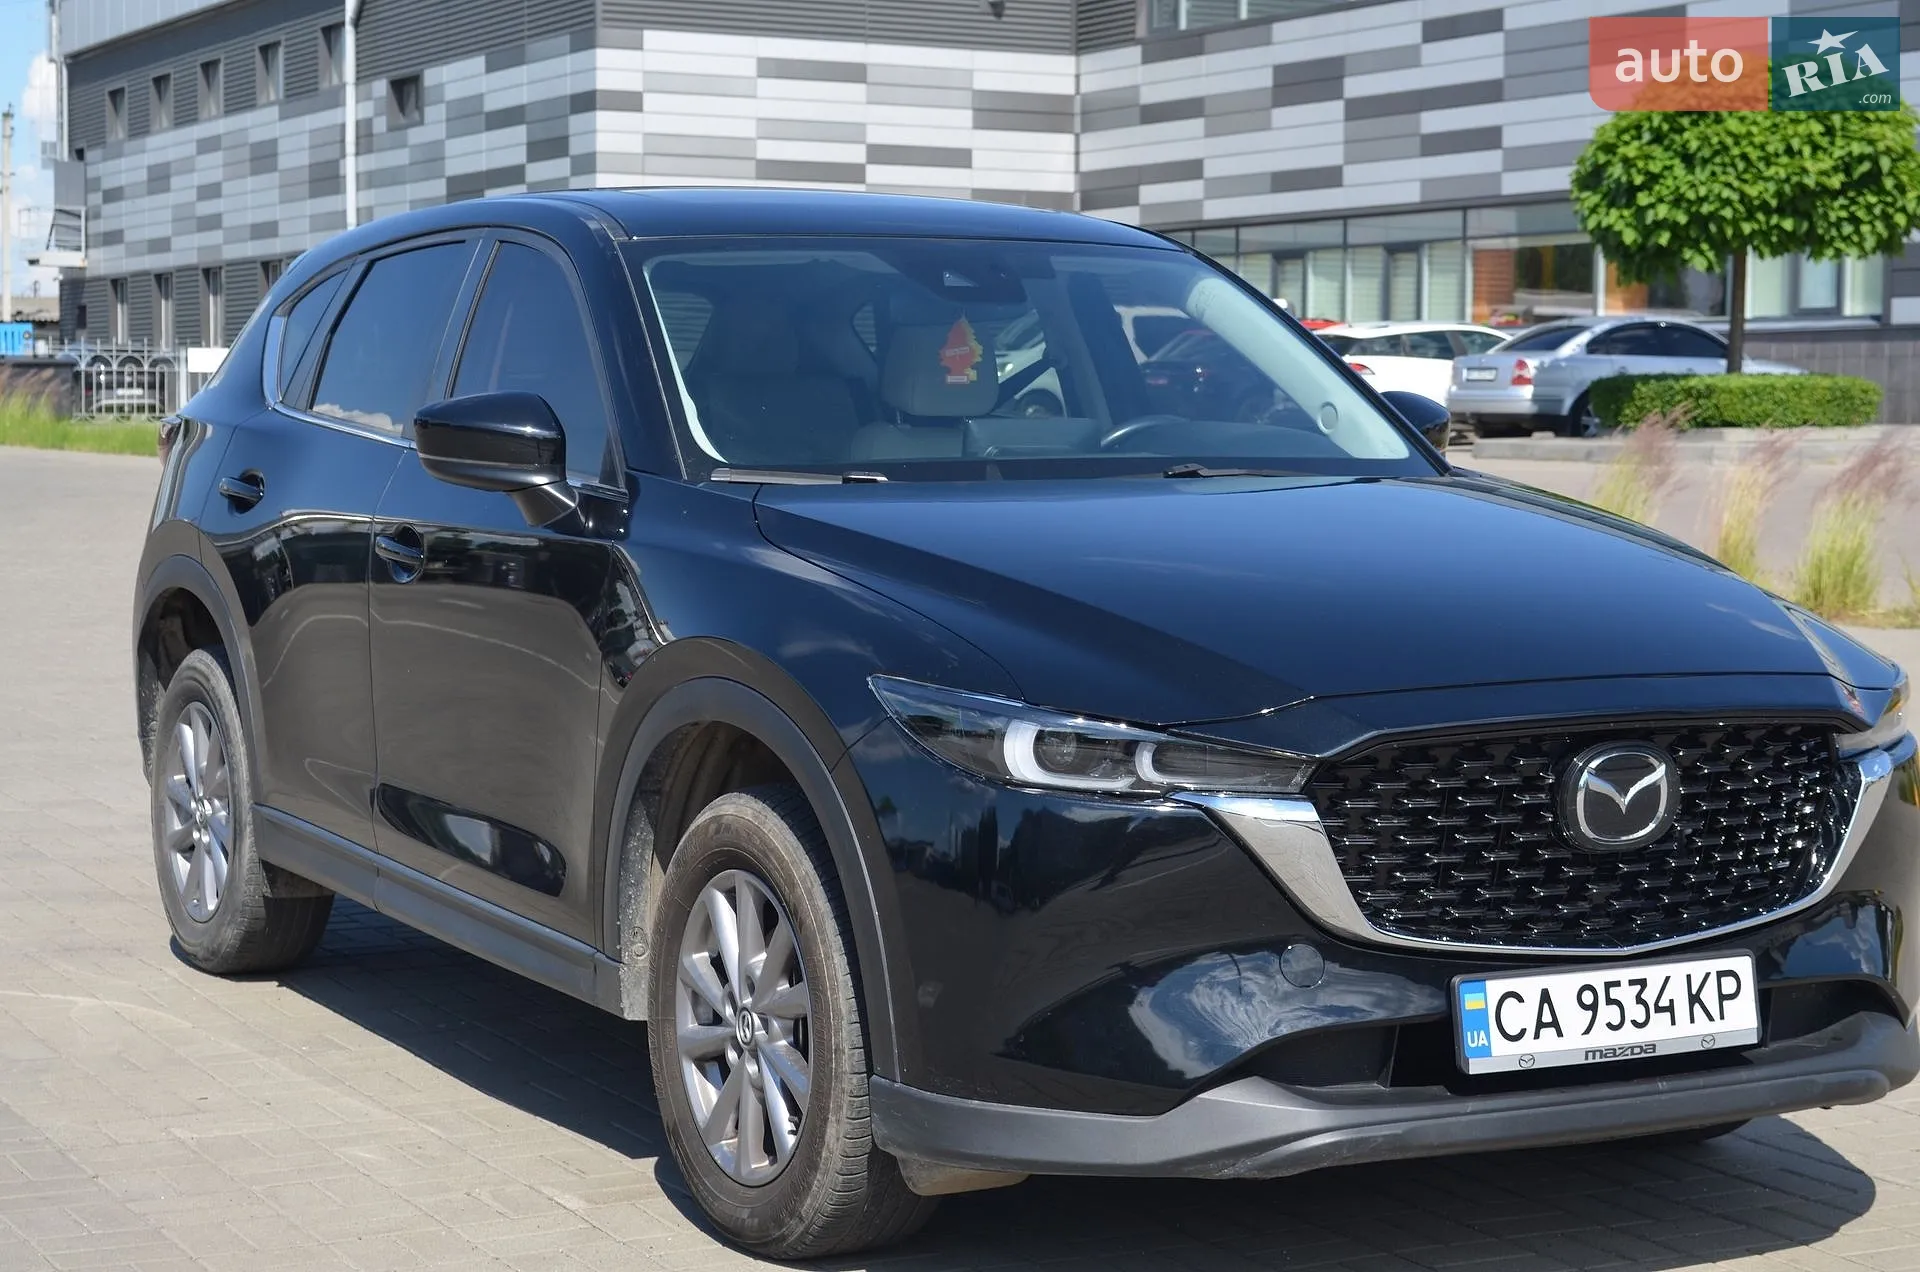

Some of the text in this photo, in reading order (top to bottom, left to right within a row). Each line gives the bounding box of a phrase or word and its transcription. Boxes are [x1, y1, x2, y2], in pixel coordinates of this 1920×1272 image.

[1494, 969, 1742, 1043] CA 9534 KP
[1467, 1030, 1489, 1049] UA
